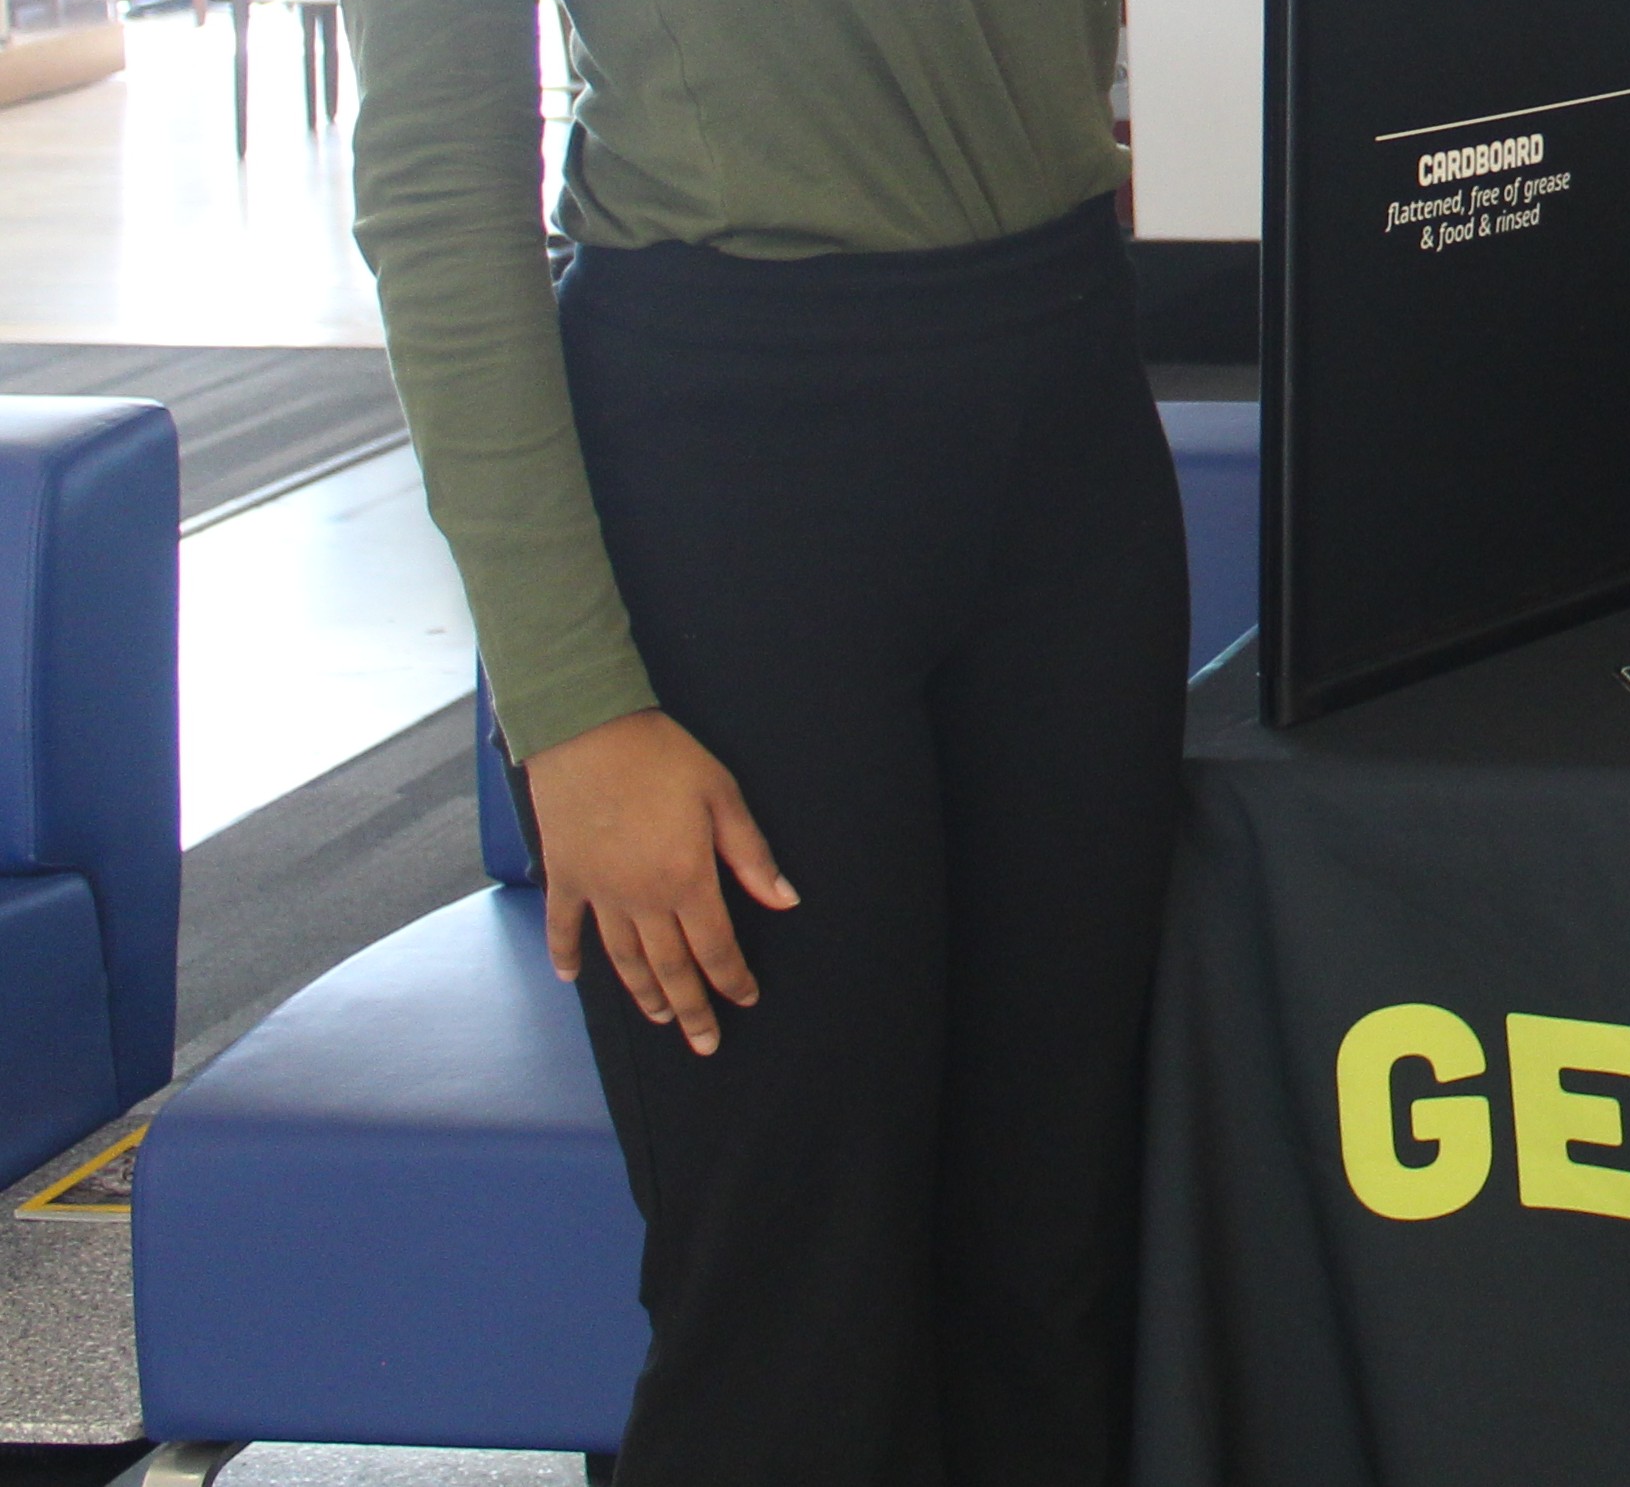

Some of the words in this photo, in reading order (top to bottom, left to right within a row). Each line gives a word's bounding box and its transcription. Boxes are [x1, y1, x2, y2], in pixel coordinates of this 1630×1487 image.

[1418, 133, 1544, 187] CARDBOARD
[1385, 189, 1465, 232] flattened,
[1467, 185, 1501, 216] free
[1503, 177, 1522, 204] of
[1523, 171, 1571, 199] grease
[1420, 225, 1434, 250] &
[1436, 216, 1475, 253] food
[1478, 213, 1491, 237] &
[1495, 204, 1542, 234] rinsed
